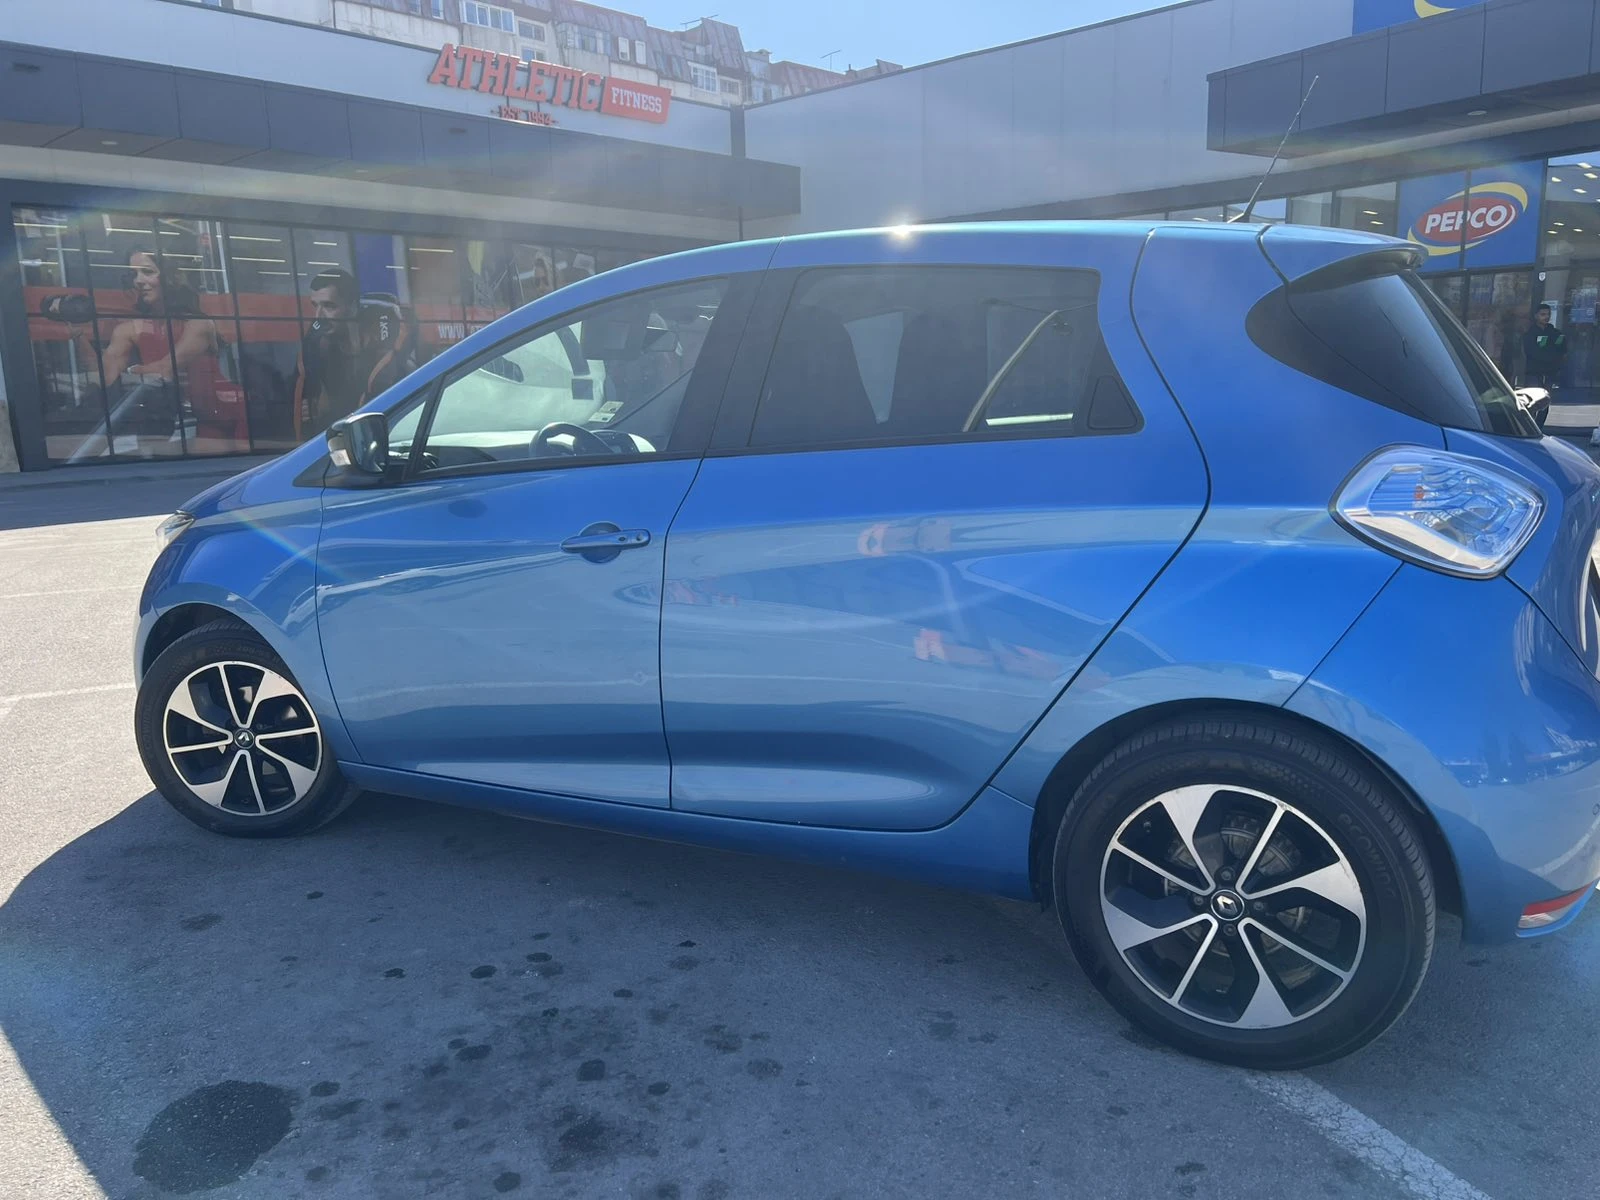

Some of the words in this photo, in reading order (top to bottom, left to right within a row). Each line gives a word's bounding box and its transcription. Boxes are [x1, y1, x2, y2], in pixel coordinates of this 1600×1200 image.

[428, 43, 602, 111] ATHLETIC
[611, 87, 662, 113] FITNESS
[1424, 205, 1508, 234] PEPCO
